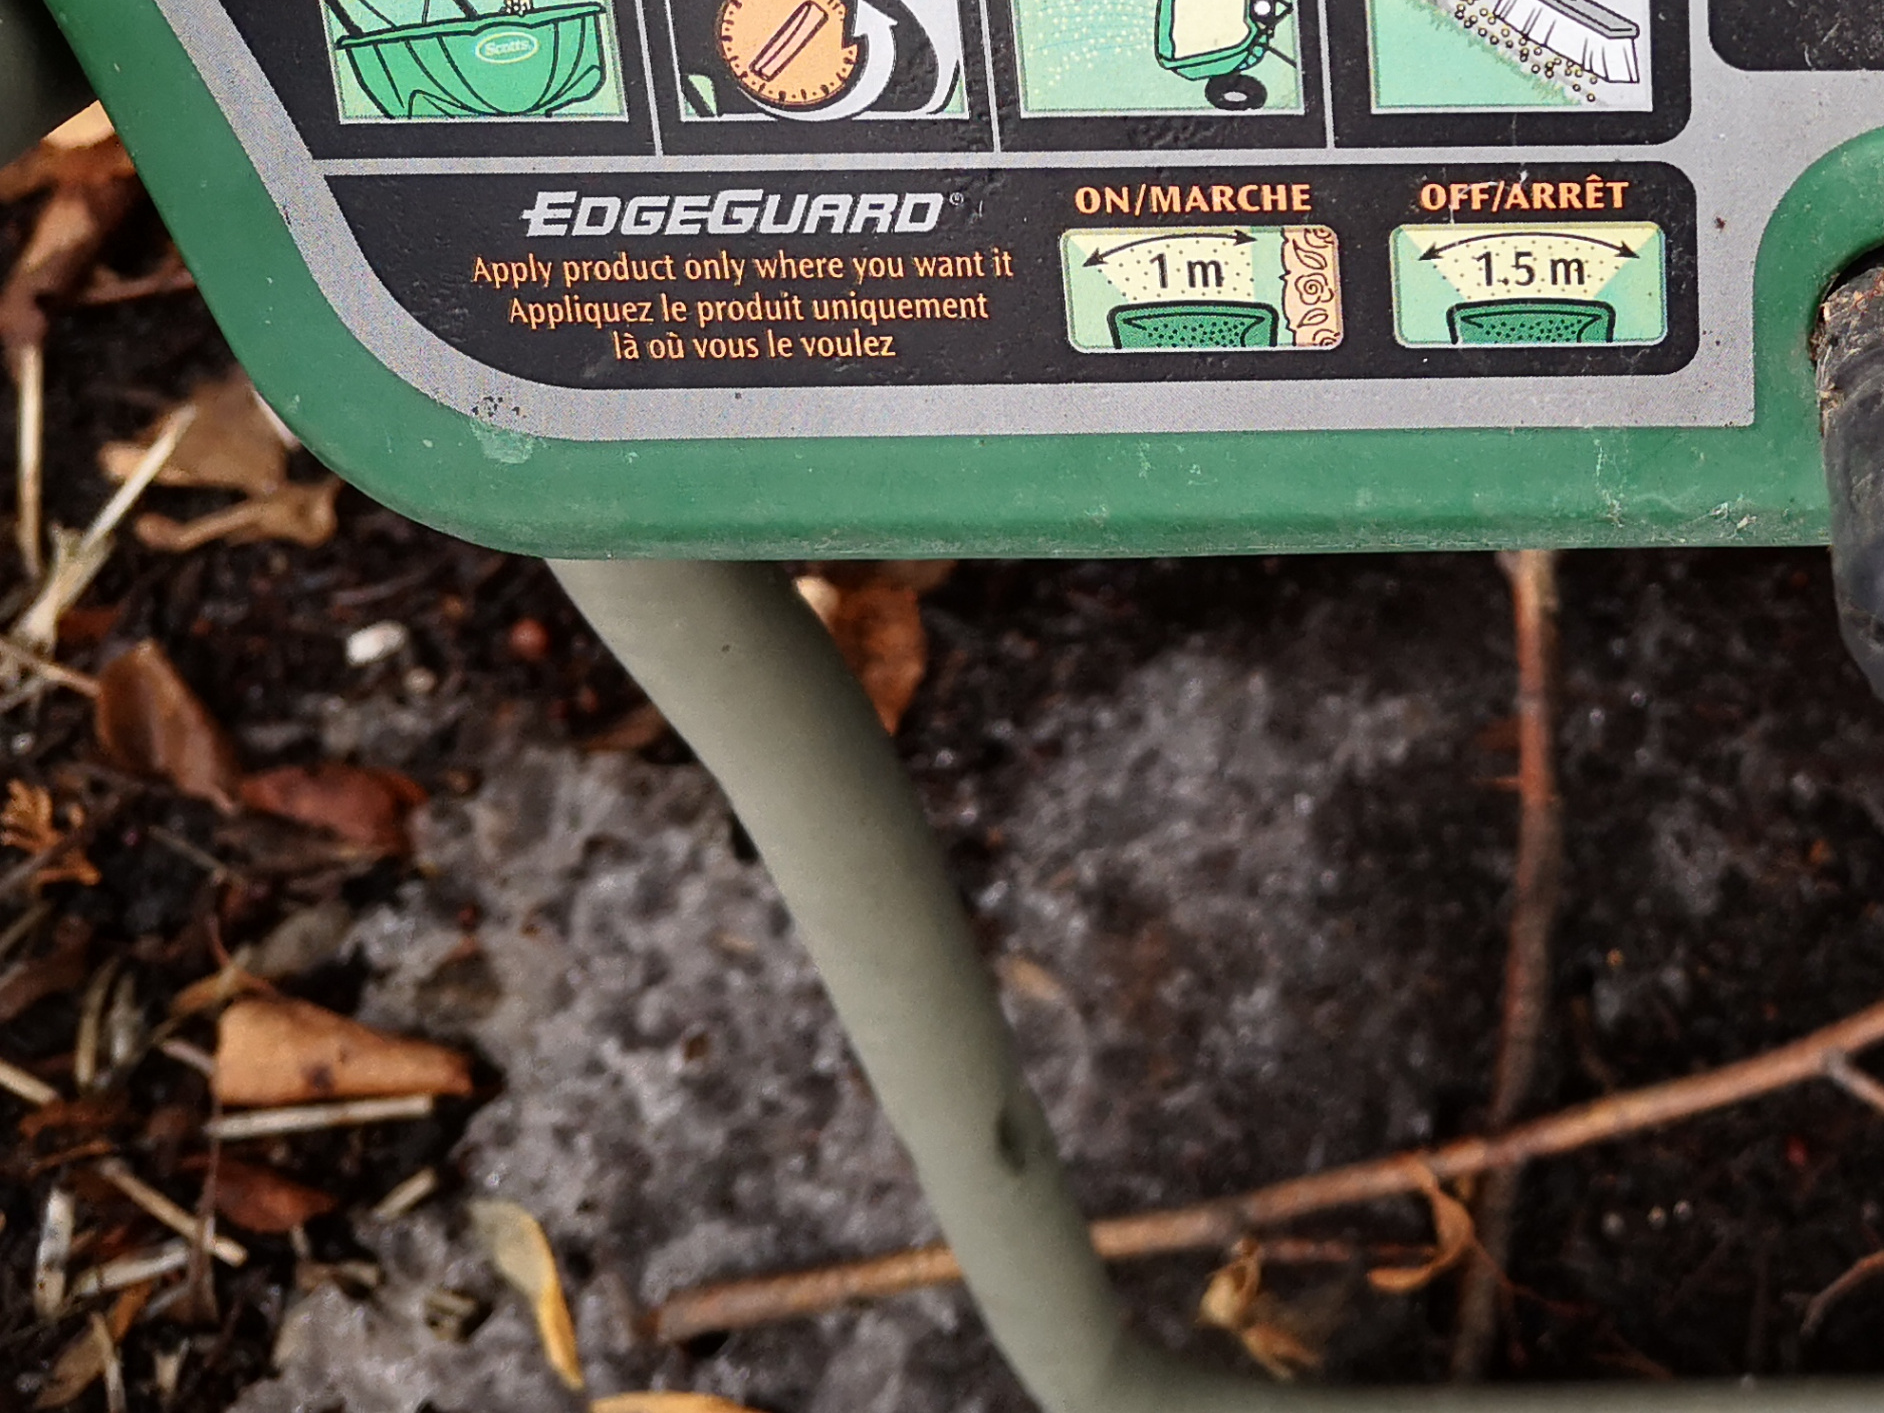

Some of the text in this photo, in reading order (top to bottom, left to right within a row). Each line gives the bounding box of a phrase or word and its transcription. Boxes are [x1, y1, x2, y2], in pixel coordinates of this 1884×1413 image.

[1074, 182, 1312, 214] ON/MARCHE
[1420, 174, 1629, 213] OFF/ARRÊT
[473, 248, 1014, 288] Apply product only where you want it
[1149, 253, 1225, 287] 1 m
[1477, 251, 1586, 287] 1.5 m
[509, 292, 989, 330] Appliquez le produit uniquement
[613, 328, 896, 360] là où vous le voulez
